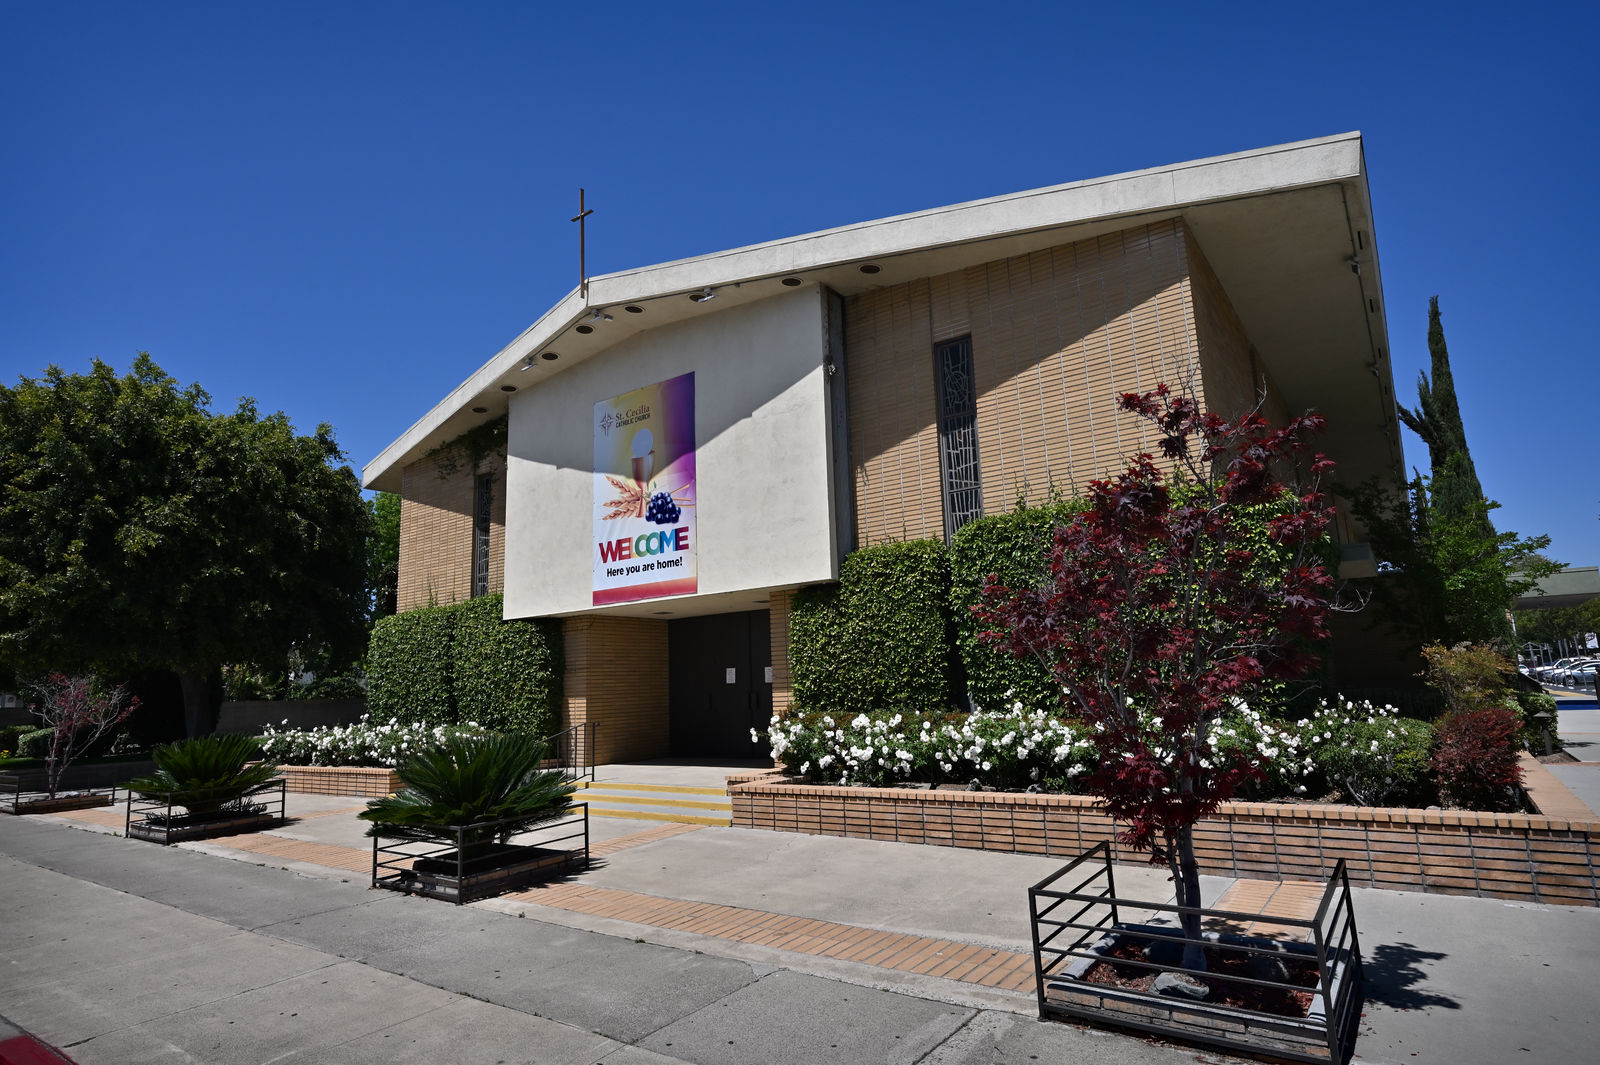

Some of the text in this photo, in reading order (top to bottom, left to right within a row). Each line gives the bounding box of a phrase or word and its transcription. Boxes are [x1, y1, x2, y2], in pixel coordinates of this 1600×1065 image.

[616, 405, 650, 421] St. Cecilia
[616, 412, 651, 428] CATHOLIC CHURCH
[599, 526, 690, 564] WELCOME
[606, 556, 683, 577] Here you are home!
